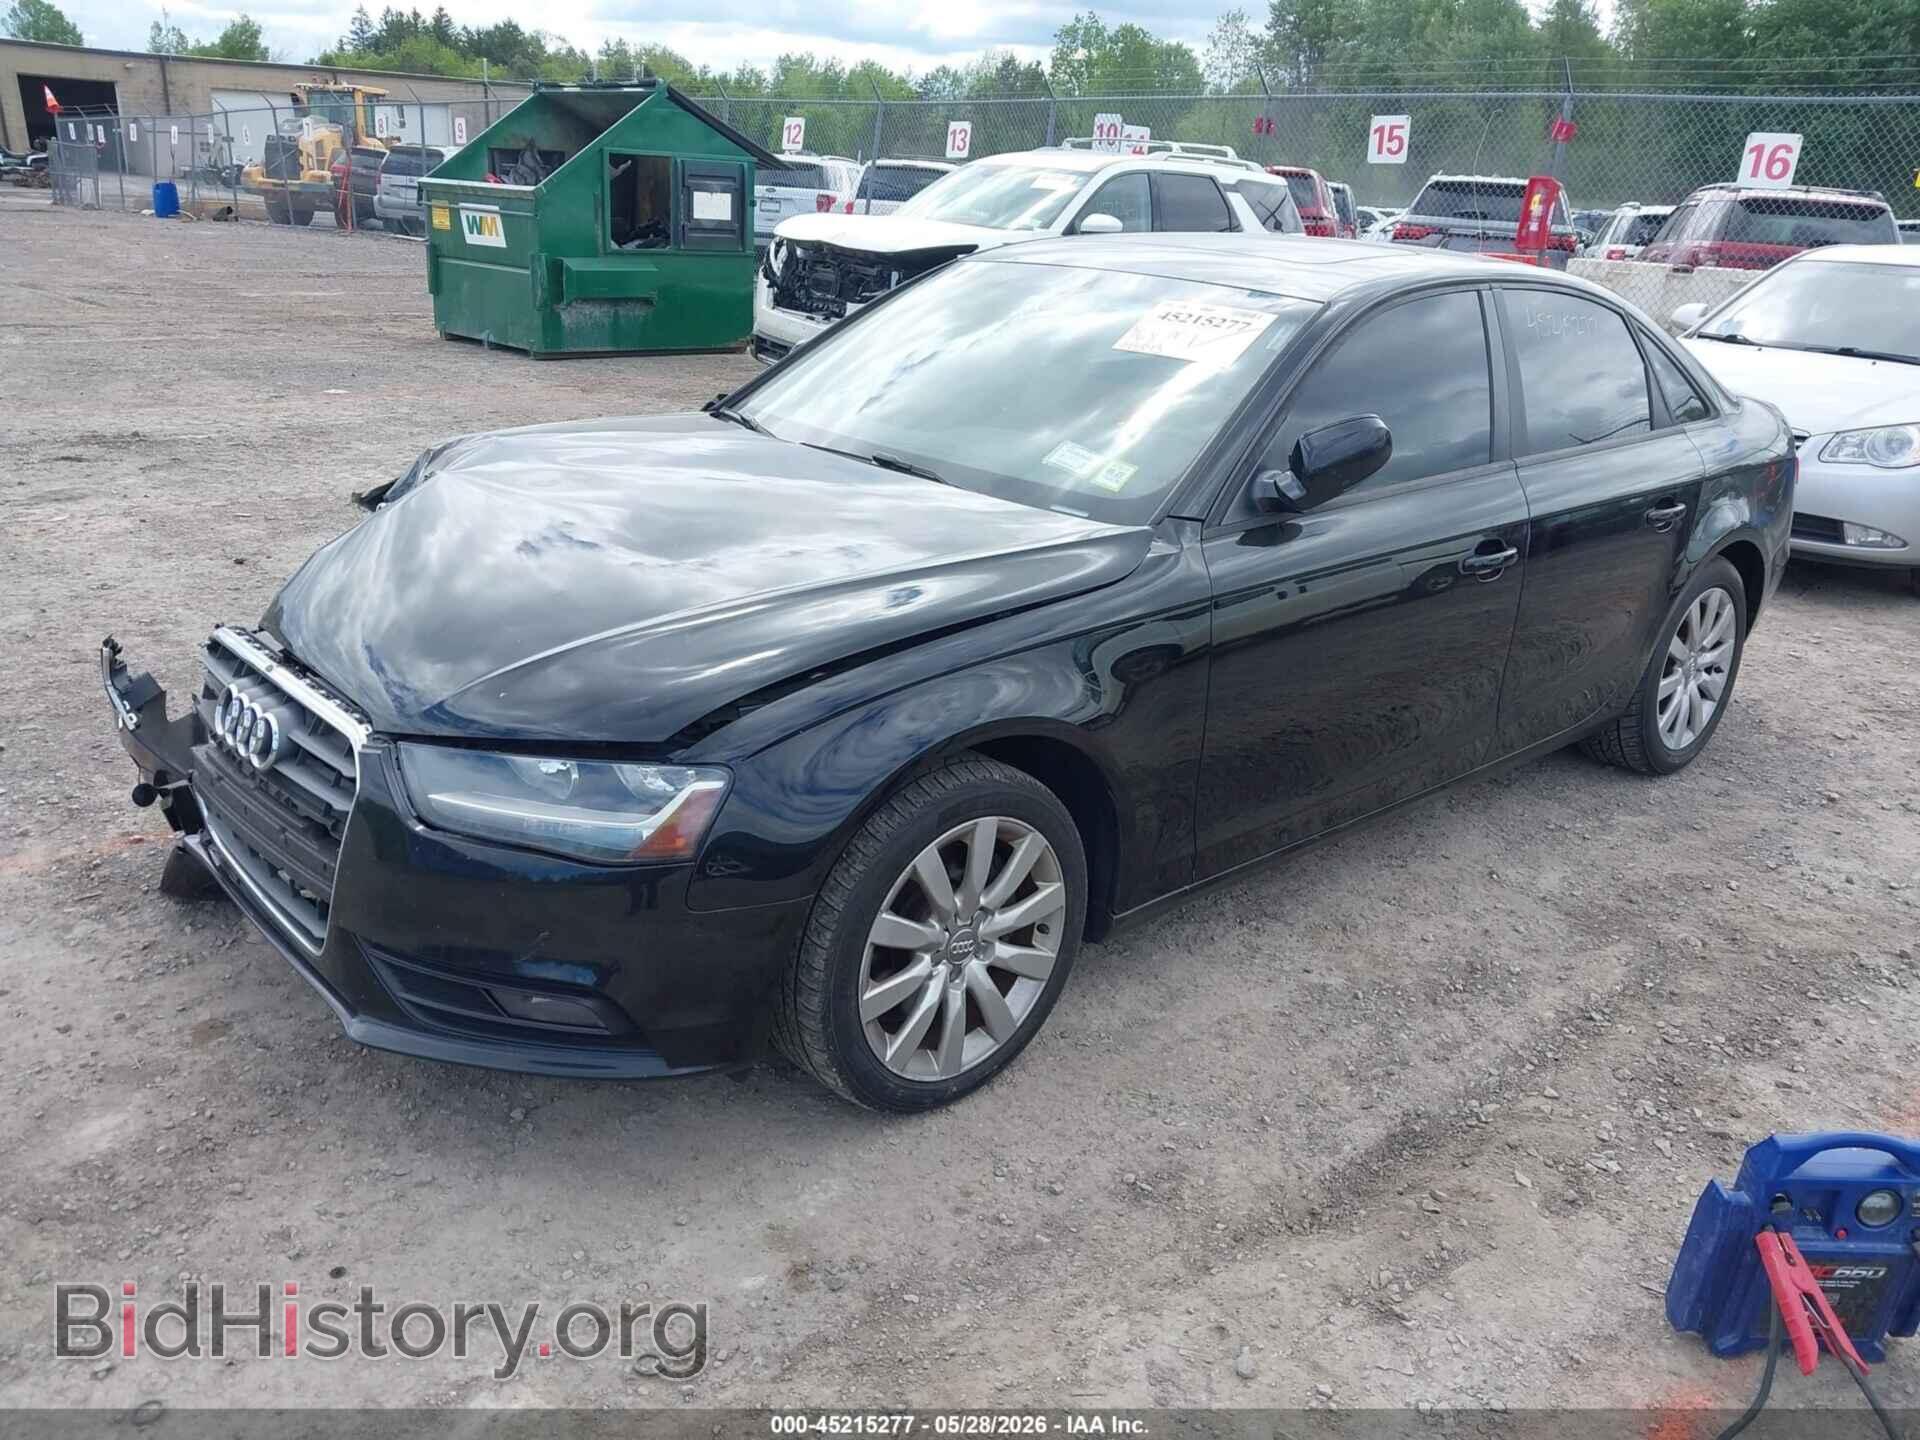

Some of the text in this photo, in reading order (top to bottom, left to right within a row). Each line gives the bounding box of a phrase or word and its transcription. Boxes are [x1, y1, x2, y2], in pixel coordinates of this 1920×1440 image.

[377, 118, 384, 134] 8
[456, 122, 464, 140] 9
[785, 124, 801, 145] 12
[1097, 123, 1118, 146] 10
[950, 128, 968, 151] 13
[1373, 124, 1405, 156] 15
[1748, 143, 1794, 180] 16
[466, 215, 500, 237] WM
[1157, 311, 1252, 330] 45215277
